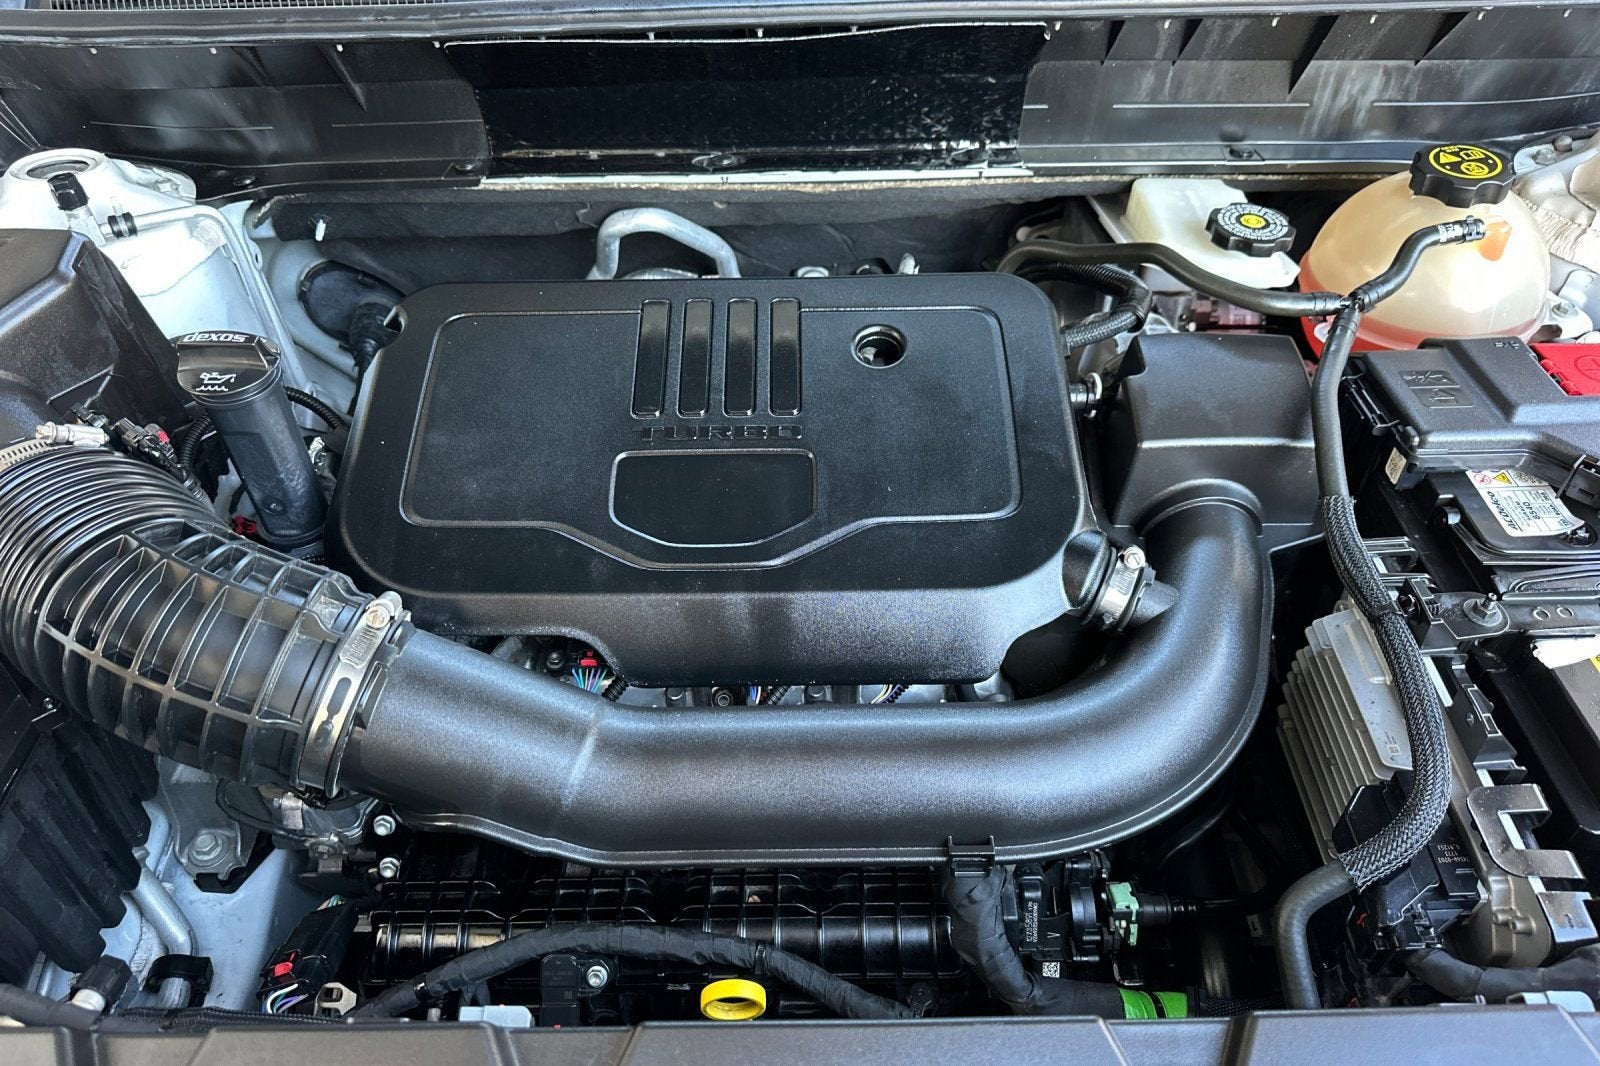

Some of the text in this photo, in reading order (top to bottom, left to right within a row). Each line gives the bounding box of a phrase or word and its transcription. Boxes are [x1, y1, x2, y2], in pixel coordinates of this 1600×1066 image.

[182, 332, 249, 343] dexos
[632, 424, 803, 441] TURBO
[1487, 491, 1518, 531] ACDelco
